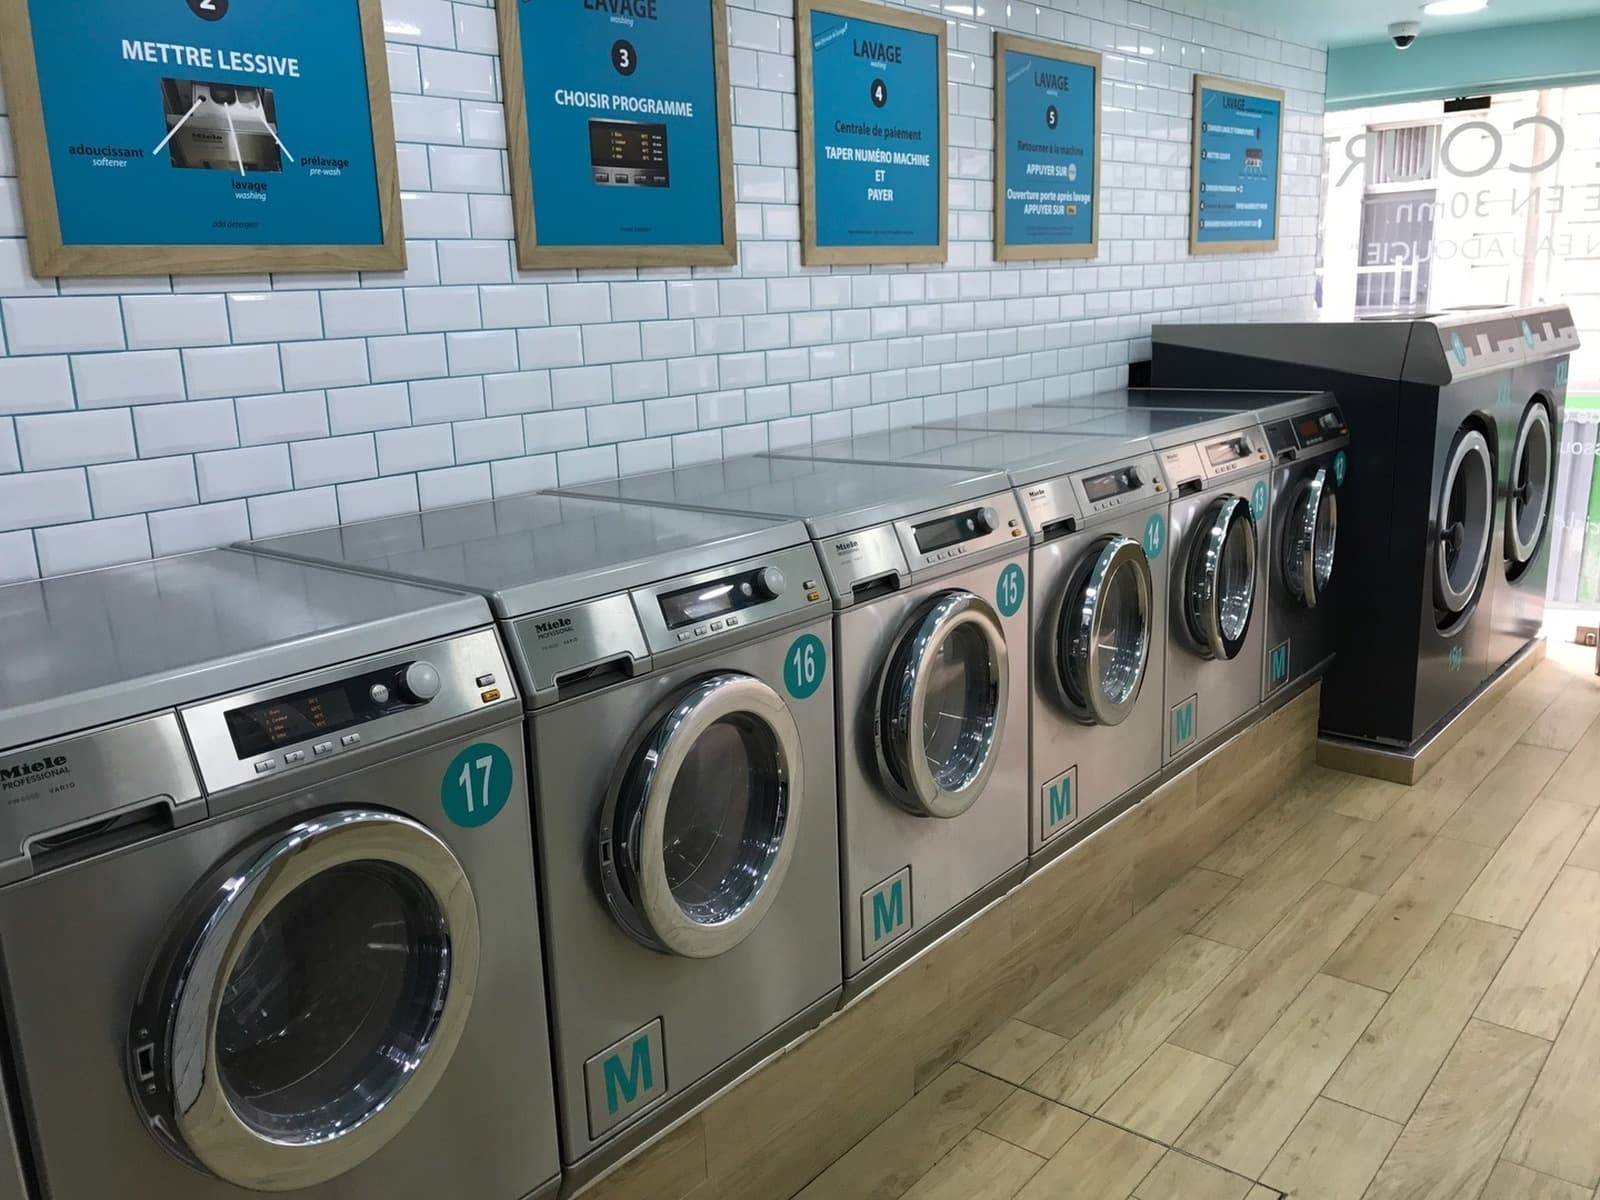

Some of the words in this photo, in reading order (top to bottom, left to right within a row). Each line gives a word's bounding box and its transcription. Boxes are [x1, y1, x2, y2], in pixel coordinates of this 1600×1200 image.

[584, 0, 658, 20] LAVAGE
[121, 39, 214, 69] METTRE
[218, 50, 300, 78] LESSIVE
[618, 49, 630, 68] 3
[853, 39, 902, 64] LAVAGE
[1034, 71, 1068, 92] LAVAGE
[875, 85, 883, 102] 4
[554, 89, 610, 110] CHOISIR
[612, 95, 693, 118] PROGRAMME
[1049, 110, 1056, 125] 5
[834, 120, 870, 136] Centrale
[872, 122, 882, 136] de
[884, 126, 922, 141] paiement
[68, 144, 144, 158] adoucissant
[825, 146, 854, 160] TAPER
[854, 148, 892, 164] NUMÉRO
[893, 151, 930, 167] MACHINE
[1017, 140, 1048, 154] Retourner
[92, 157, 127, 168] softener
[301, 155, 350, 171] prélavage
[310, 167, 341, 176] pre-wash
[1026, 164, 1054, 177] APPUYER
[1056, 165, 1068, 178] SUR
[875, 170, 886, 182] ET
[231, 178, 268, 194] lavage
[868, 188, 894, 201] PAYER
[1007, 188, 1040, 200] Ouverture
[1040, 191, 1056, 202] porte
[235, 190, 267, 202] washing
[1024, 204, 1051, 215] APPUYER
[1052, 204, 1064, 216] SUR
[1254, 485, 1264, 513] 13
[835, 539, 858, 552] Miele
[1148, 524, 1159, 552] 14
[1002, 571, 1018, 606] 15
[534, 616, 572, 634] Miele
[538, 626, 575, 641] PROFESSIONAL
[793, 642, 816, 688] 16
[1272, 645, 1286, 682] M
[1176, 702, 1192, 745] M
[0, 755, 67, 782] Miele
[2, 766, 70, 791] PROFESSIONAL
[50, 782, 76, 794] VARIO
[458, 754, 493, 813] 17
[1049, 776, 1070, 826] M
[872, 879, 904, 942] M
[604, 1034, 653, 1116] M
